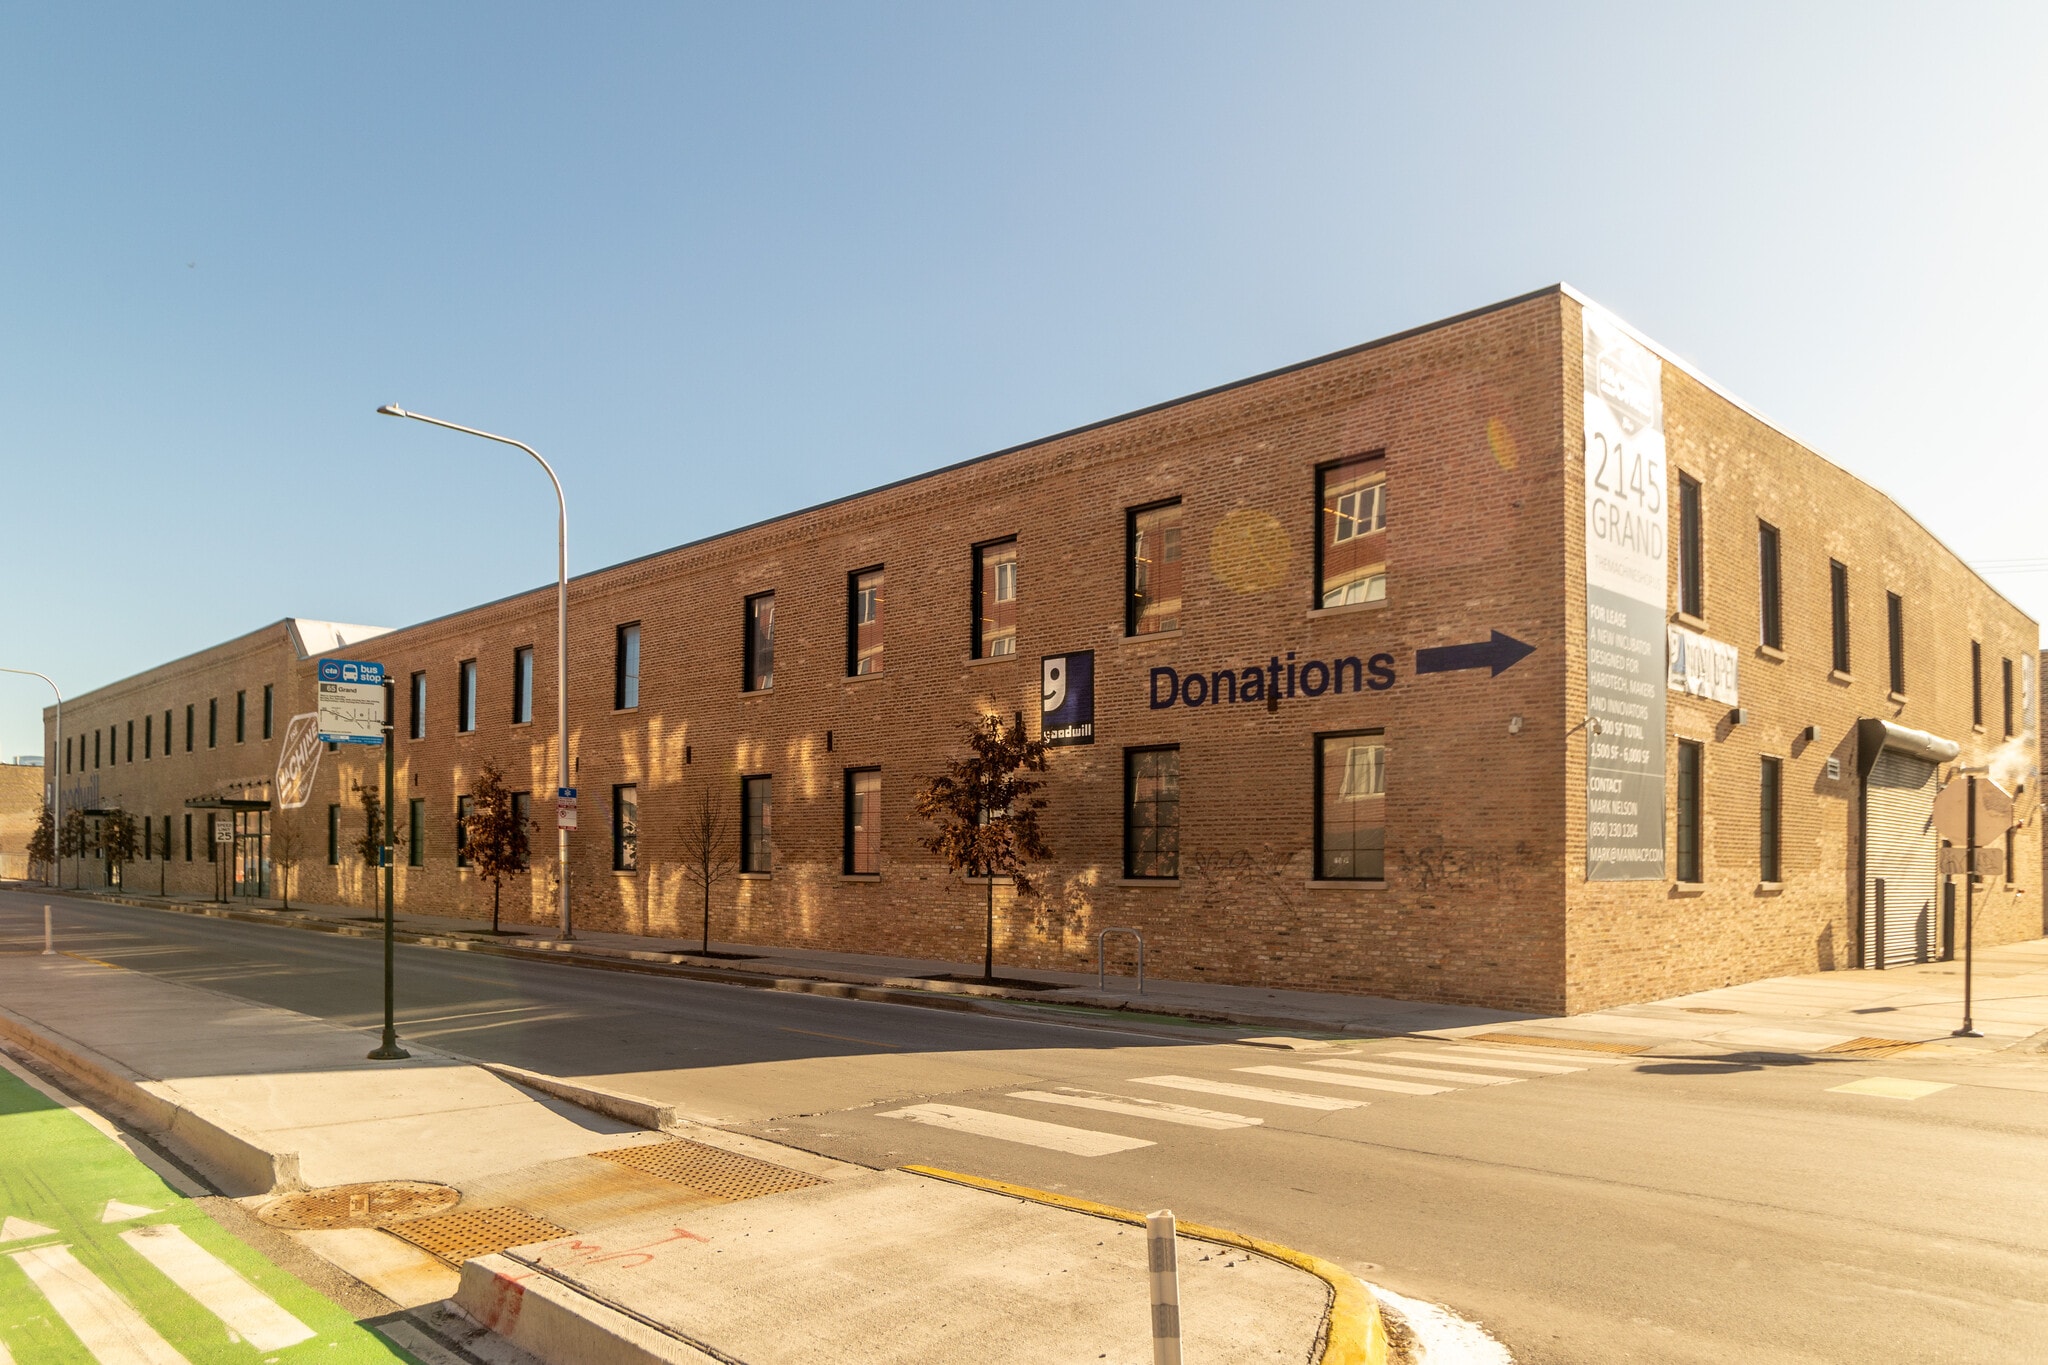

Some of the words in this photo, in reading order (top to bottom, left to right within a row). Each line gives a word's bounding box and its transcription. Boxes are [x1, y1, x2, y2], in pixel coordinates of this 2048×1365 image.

[1594, 432, 1660, 514] 2145
[1592, 498, 1662, 560] GRAND
[1590, 604, 1605, 622] FOR
[1606, 609, 1627, 628] LEASE
[1590, 626, 1596, 641] A
[1597, 628, 1614, 646] NEW
[1615, 634, 1651, 656] INCUBATOR
[361, 664, 377, 674] bus
[1591, 648, 1625, 670] DESIGNED
[1626, 657, 1640, 673] FOR
[361, 674, 381, 684] stop
[1150, 652, 1396, 709] Donations
[1591, 670, 1629, 695] HARDTECH,
[1630, 680, 1655, 699] MAKERS
[1591, 696, 1606, 711] AND
[1607, 699, 1648, 720] INNOVATORS
[1043, 723, 1092, 744] goodwill
[1615, 721, 1623, 736] SF
[1624, 723, 1644, 740] TOTAL
[279, 721, 318, 789] MACHINE
[1591, 742, 1610, 760] 1,500
[1610, 745, 1619, 760] SF
[1642, 750, 1650, 764] SF
[1590, 776, 1622, 793] CONTACT
[1590, 798, 1611, 814] MARK
[1612, 800, 1638, 816] NELSON
[217, 832, 232, 840] 25
[1590, 821, 1608, 839] (858)
[1609, 822, 1621, 838] 230
[1622, 823, 1638, 838] 1204
